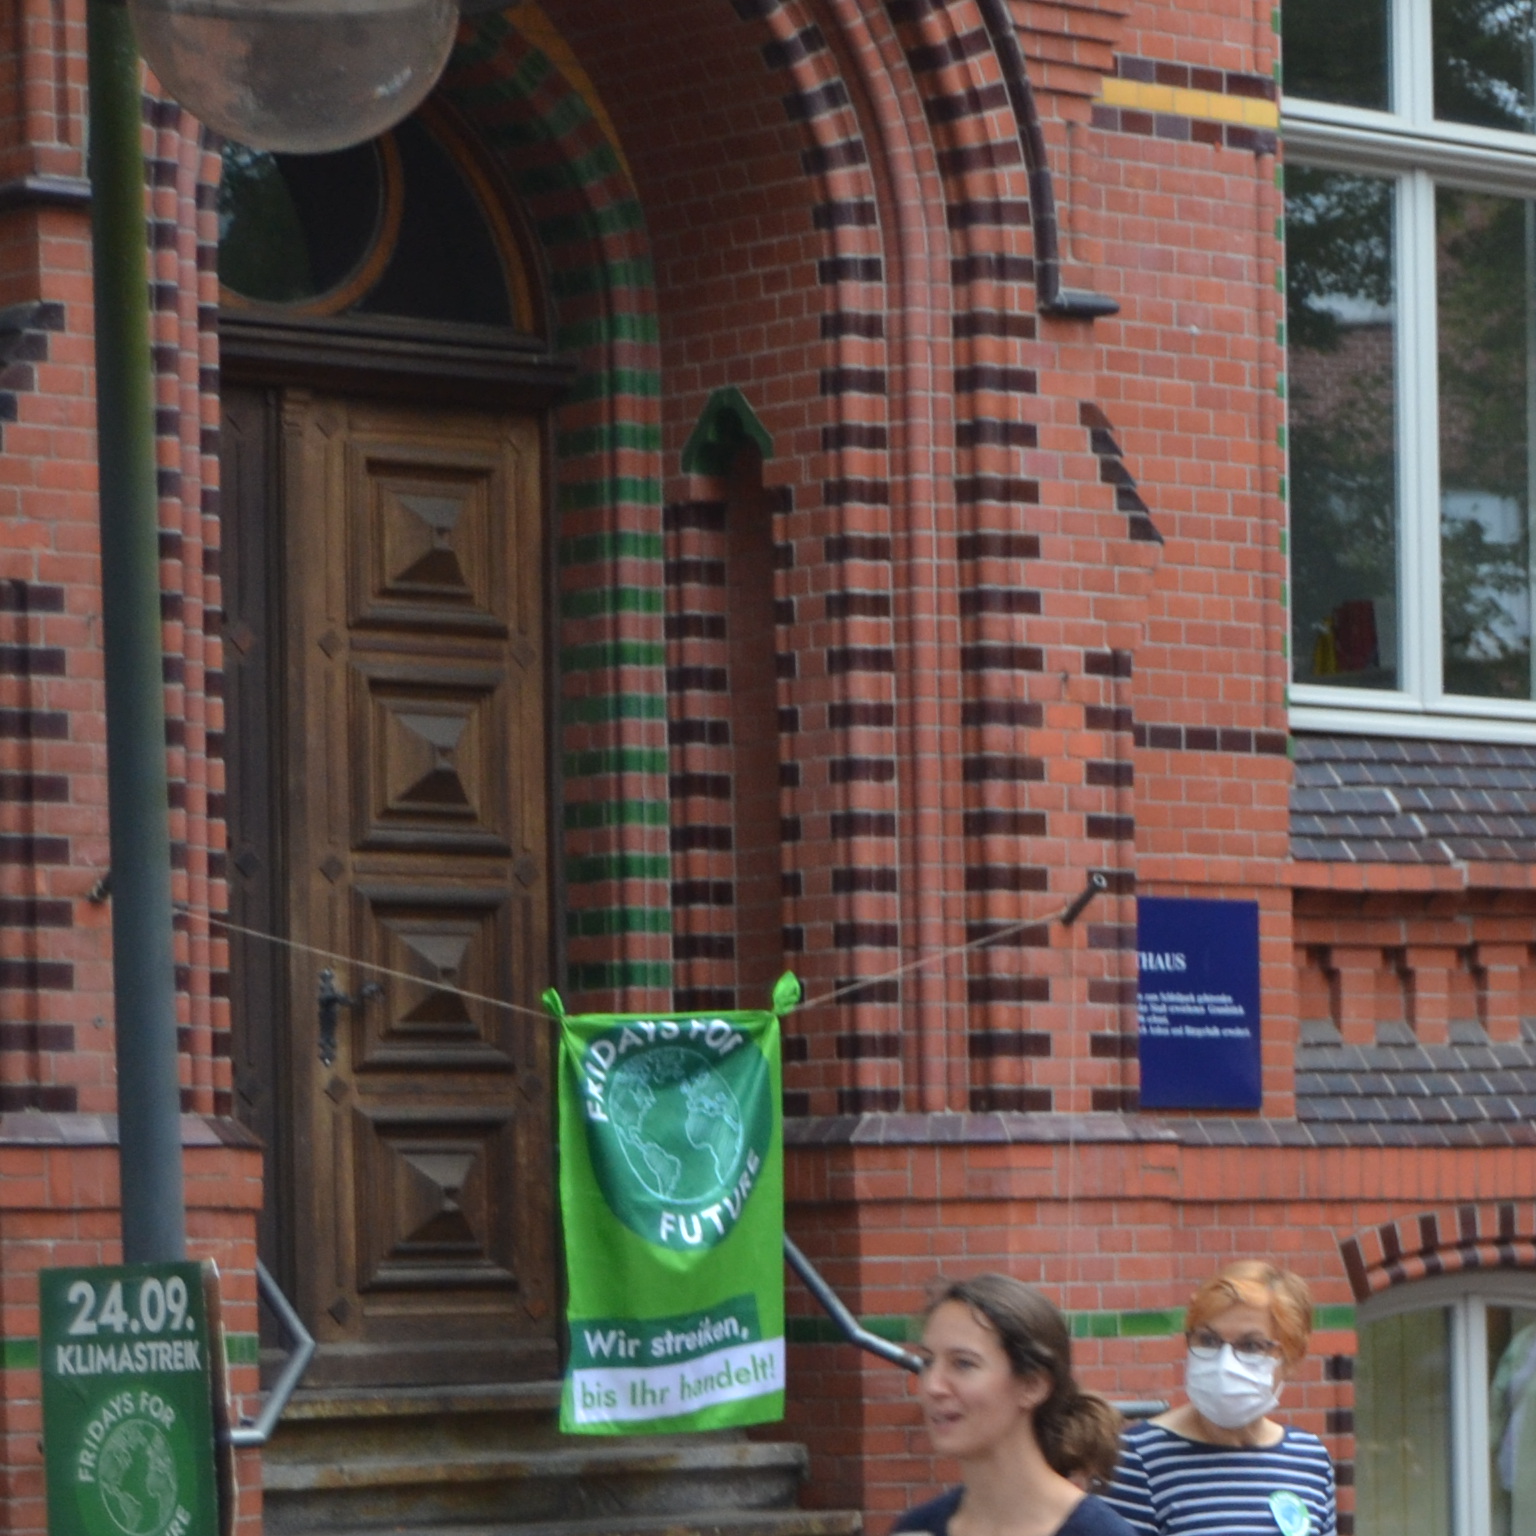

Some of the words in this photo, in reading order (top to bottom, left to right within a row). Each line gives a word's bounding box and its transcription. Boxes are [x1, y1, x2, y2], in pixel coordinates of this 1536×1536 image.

[586, 1020, 680, 1123] FRIDAYS
[689, 1018, 743, 1056] FOR
[659, 1147, 760, 1244] FUTURE
[68, 1275, 195, 1335] 24.09.
[57, 1339, 202, 1375] KLIMASTREIK
[583, 1330, 642, 1359] Wir
[650, 1315, 750, 1359] streiken,
[581, 1381, 617, 1409] bis
[631, 1379, 670, 1407] Ihr
[679, 1353, 776, 1401] handelt!
[78, 1391, 135, 1483] FRIDAYS
[139, 1390, 176, 1431] FOR
